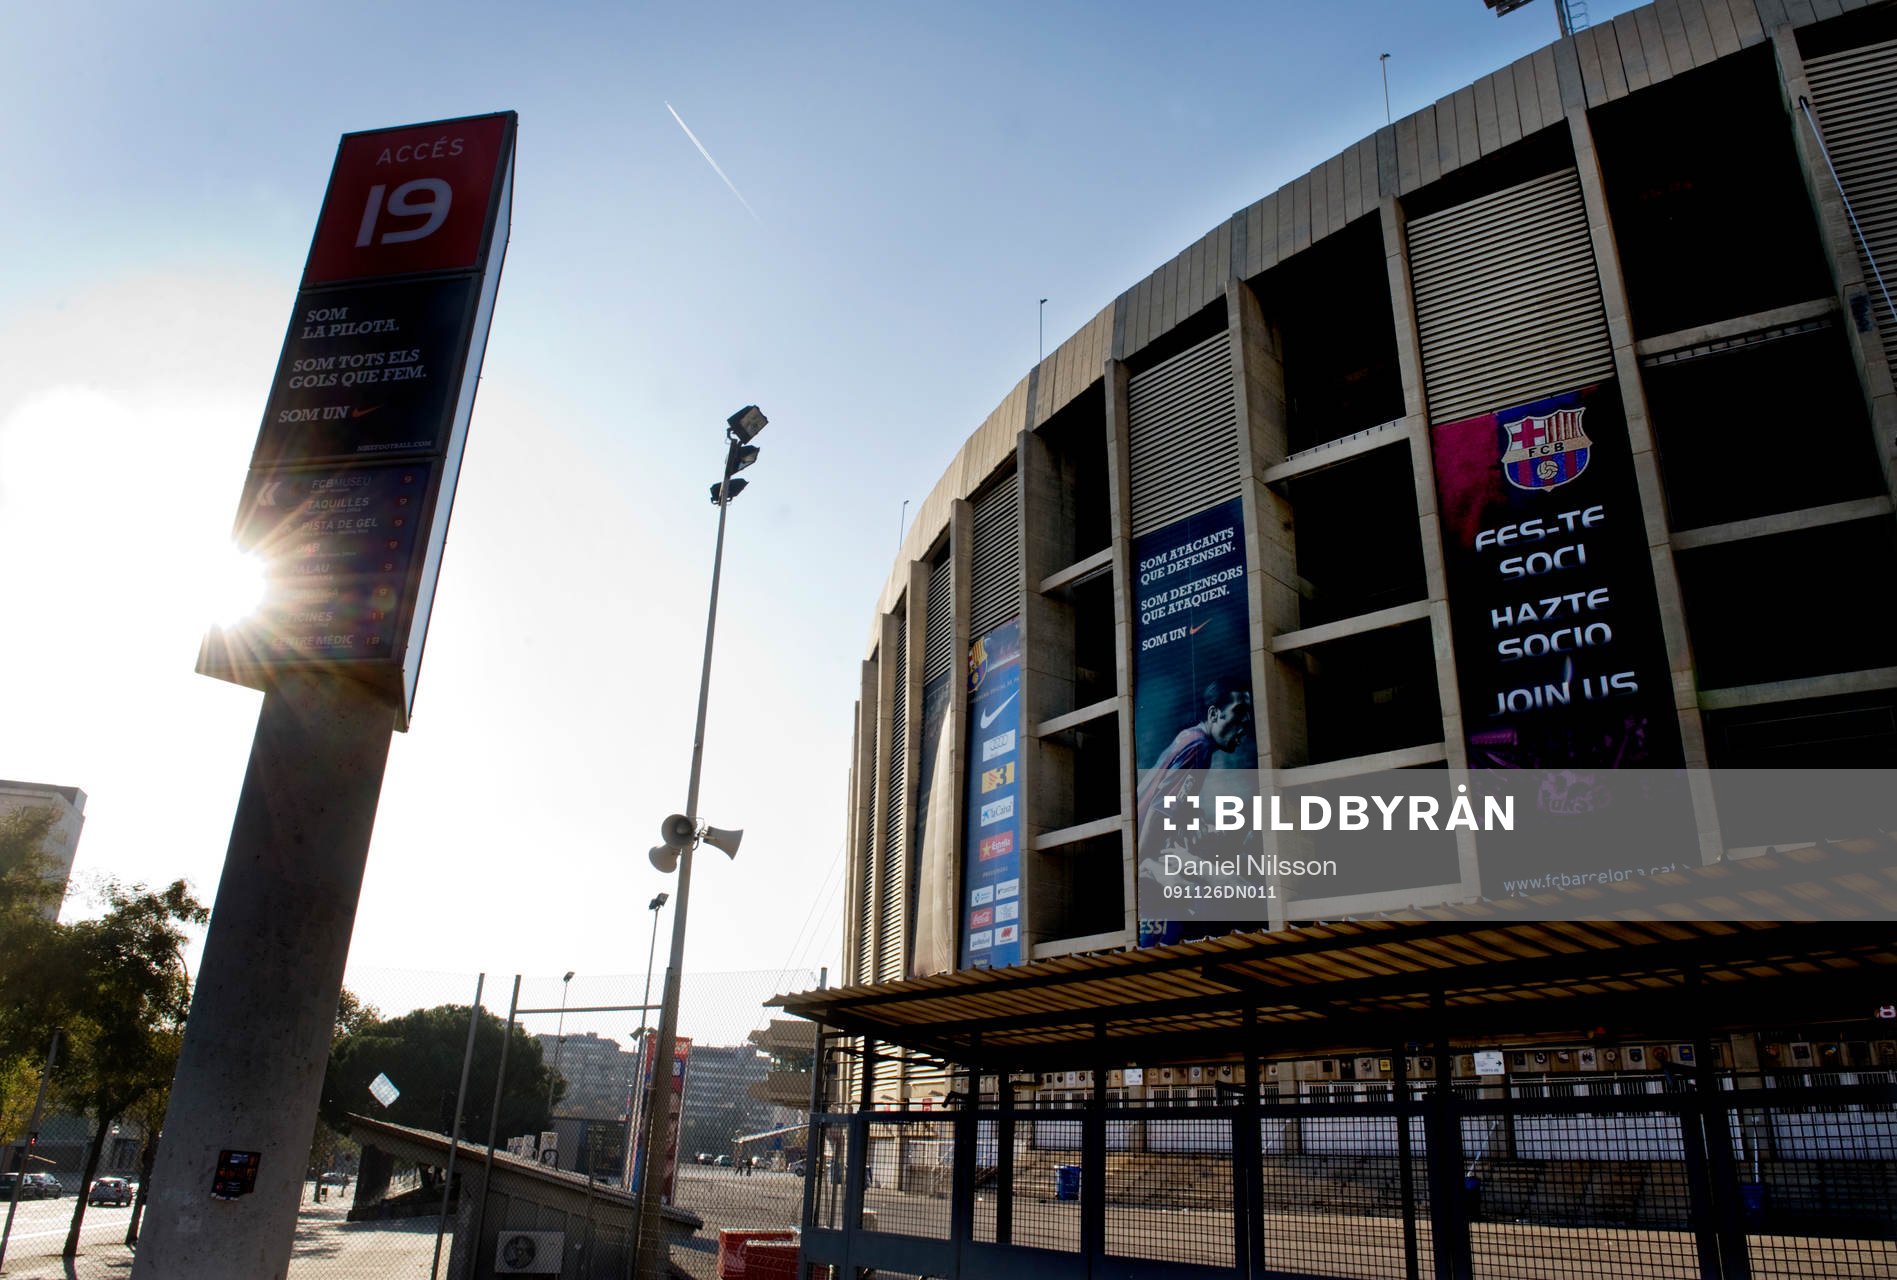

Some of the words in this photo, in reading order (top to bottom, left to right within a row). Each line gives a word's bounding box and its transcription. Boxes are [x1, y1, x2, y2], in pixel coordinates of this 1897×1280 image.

[376, 136, 464, 166] ACCÉS
[354, 177, 453, 248] 19
[301, 326, 326, 339] LA
[328, 319, 399, 337] PILOTA.
[305, 307, 348, 322] SOM
[289, 373, 338, 389] GOLS
[341, 370, 379, 386] QUE
[383, 365, 427, 382] FEM.
[293, 357, 336, 372] SOM
[338, 352, 384, 368] TOTS
[388, 349, 420, 364] ELS
[278, 407, 319, 423] SOM
[324, 405, 350, 420] UN
[1528, 442, 1565, 458] FCB
[305, 497, 369, 511] TAQUILLES
[302, 519, 334, 531] PISTA
[337, 518, 354, 530] DE
[355, 517, 379, 529] GEL
[1475, 504, 1605, 552] FES-TE
[1140, 552, 1167, 572] SOM
[1169, 527, 1234, 561] ATACANTS
[1140, 566, 1165, 586] QUE
[1167, 541, 1236, 575] DEFENSEN.
[1499, 543, 1587, 580] SOCI
[1141, 592, 1168, 611] SOM
[1169, 565, 1243, 600] DEFENSORS
[1141, 606, 1166, 625] QUE
[1167, 585, 1230, 615] ATAQUEN.
[1491, 587, 1610, 630] HAZTE
[1142, 632, 1168, 651] SOM
[1169, 626, 1187, 641] UN
[1498, 622, 1612, 662] SOCIO
[1489, 680, 1570, 717] JOIN
[1583, 671, 1639, 701] US
